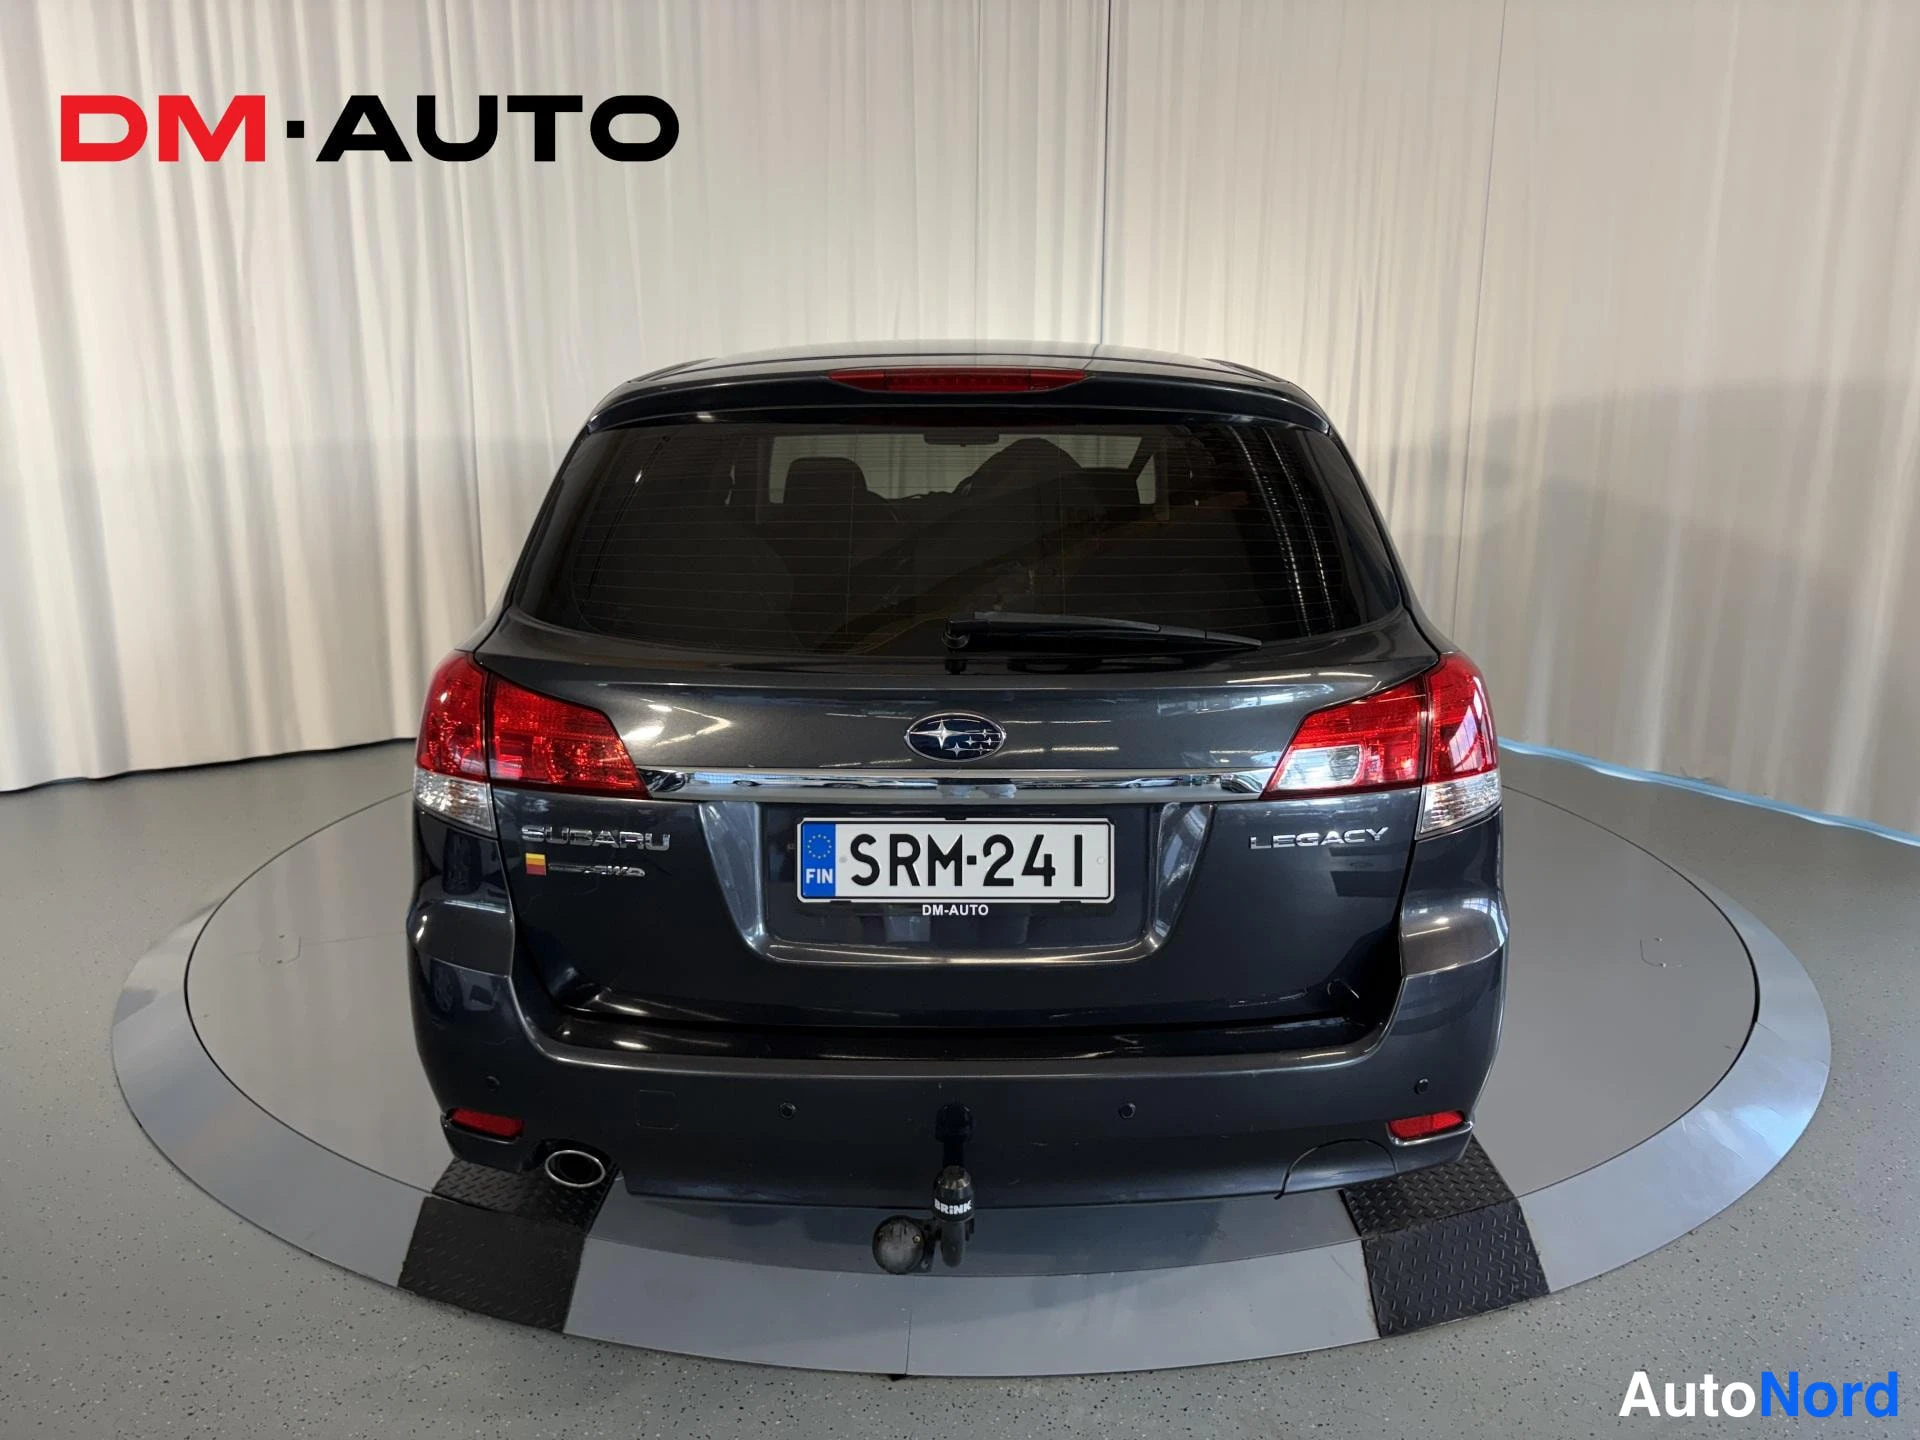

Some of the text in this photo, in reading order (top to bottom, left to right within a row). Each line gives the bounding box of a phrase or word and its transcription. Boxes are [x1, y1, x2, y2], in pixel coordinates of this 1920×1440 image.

[521, 824, 671, 851] SUBARU
[1250, 827, 1389, 850] LEGACY
[850, 833, 1083, 887] SRM-241
[805, 868, 834, 884] FIN
[922, 904, 989, 916] DM-AUTO
